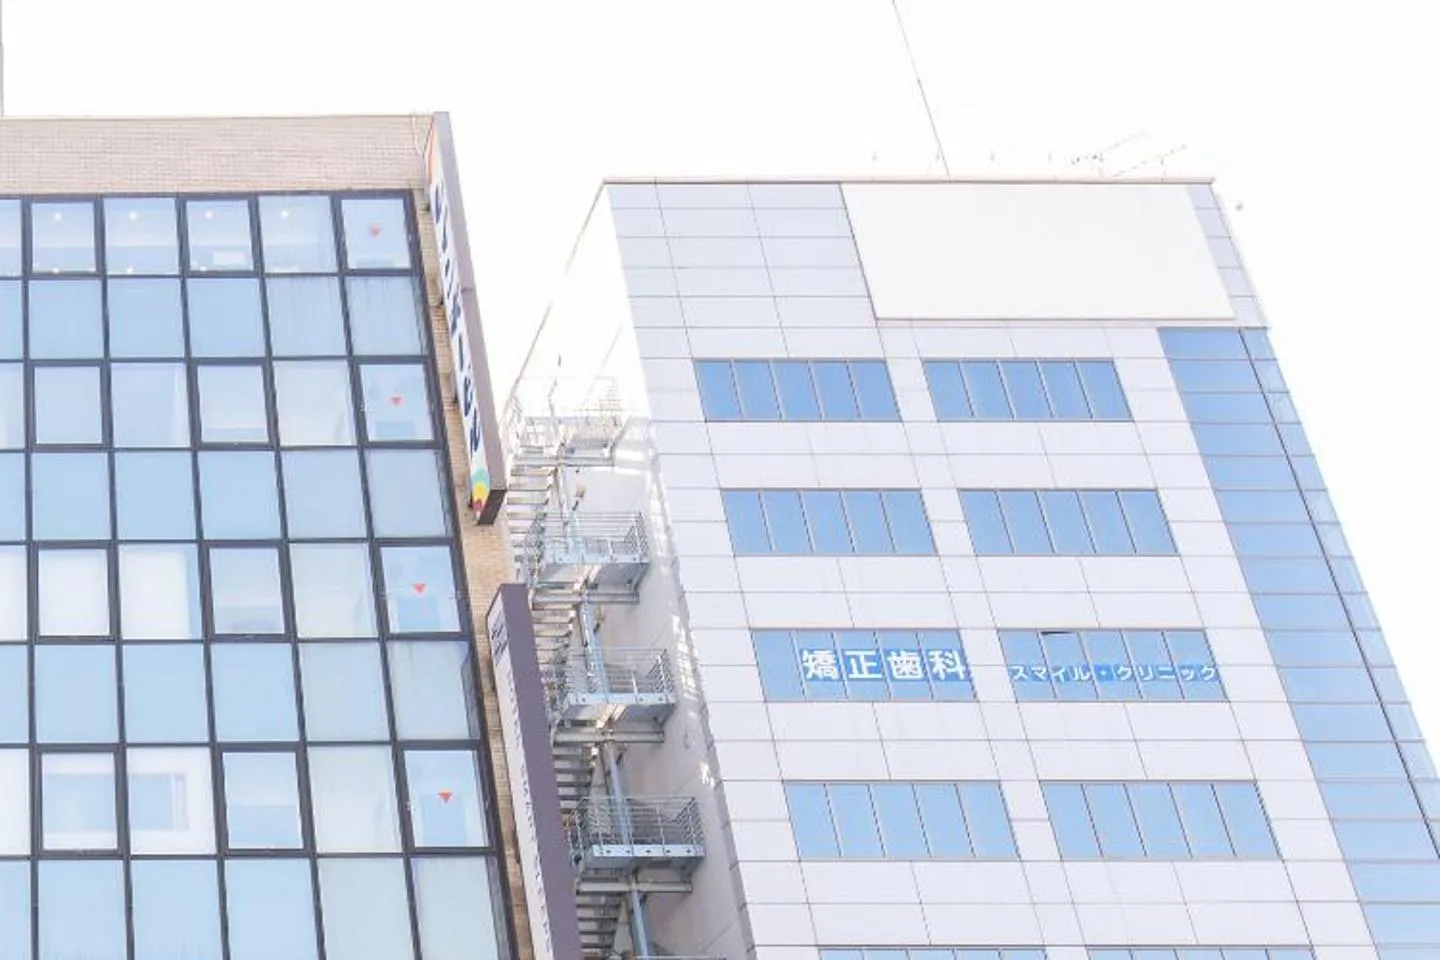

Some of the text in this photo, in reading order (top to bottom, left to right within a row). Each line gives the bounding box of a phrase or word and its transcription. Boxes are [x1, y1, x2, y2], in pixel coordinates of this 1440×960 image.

[802, 649, 965, 680] 矯正歯科
[1011, 664, 1217, 681] スマイル・クリニック
